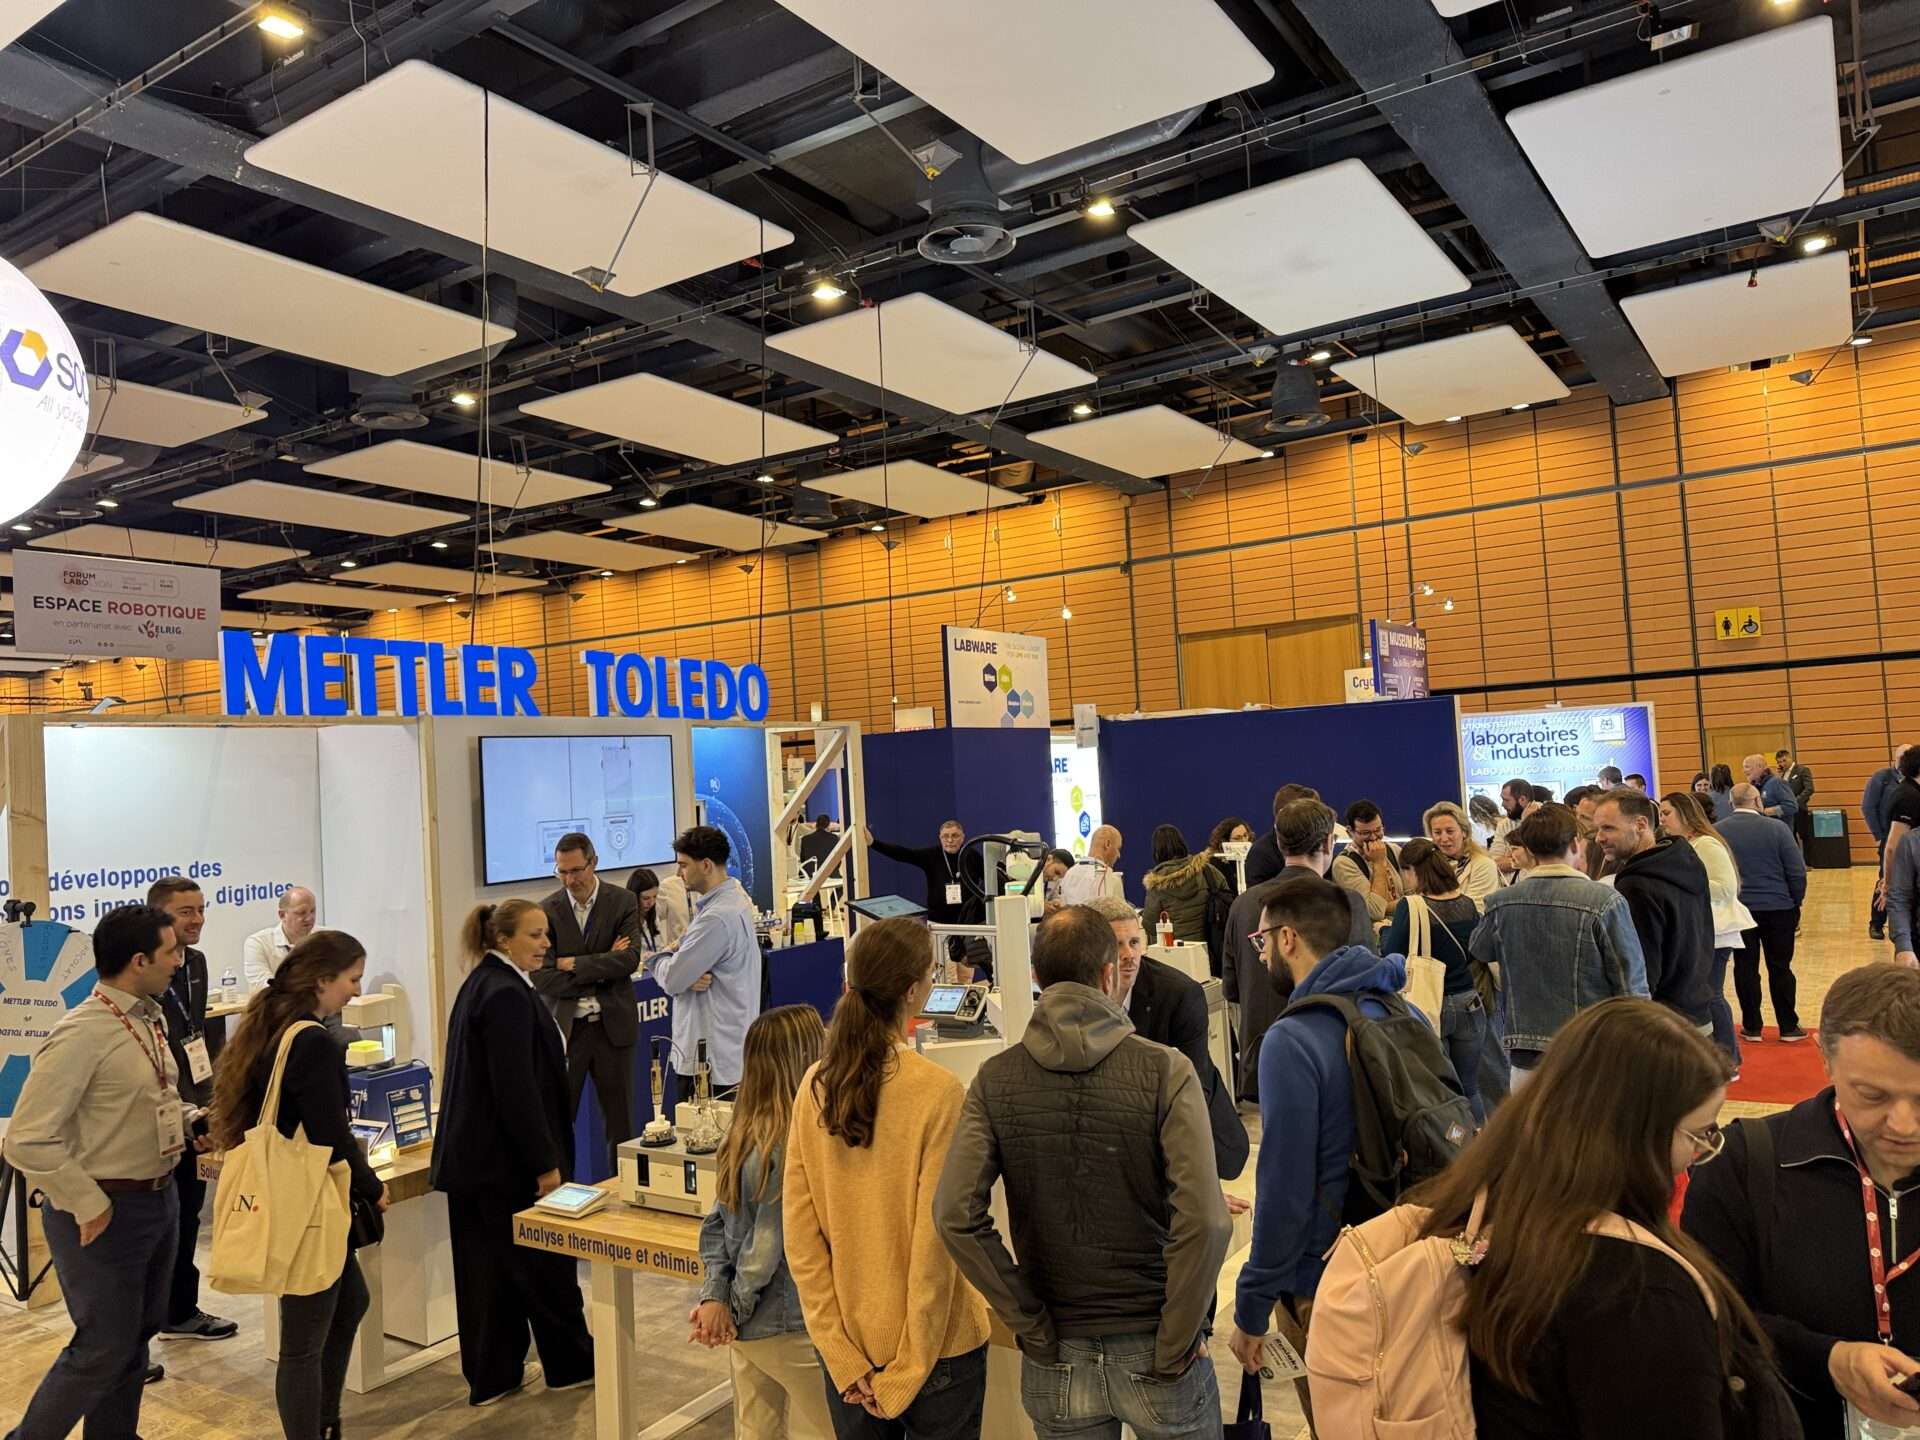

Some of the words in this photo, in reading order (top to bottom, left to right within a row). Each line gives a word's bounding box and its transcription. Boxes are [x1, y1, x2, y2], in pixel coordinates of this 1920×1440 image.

[63, 570, 96, 580] FORUM
[63, 578, 89, 587] LABO
[33, 595, 103, 613] ESPACE
[107, 601, 207, 620] ROBOTIQUE
[954, 638, 998, 655] LABWARE
[219, 630, 541, 716] METTLER
[580, 650, 770, 721] TOLEDO
[1471, 726, 1578, 746] laboratoires
[1491, 741, 1580, 760] industries
[49, 866, 181, 891] développons
[188, 860, 222, 878] des
[3, 997, 31, 1006] METTLER
[33, 999, 58, 1007] TOLEDO
[518, 1223, 564, 1247] Analyse
[568, 1232, 632, 1262] thermique
[636, 1248, 649, 1265] et
[653, 1251, 700, 1276] chimie
